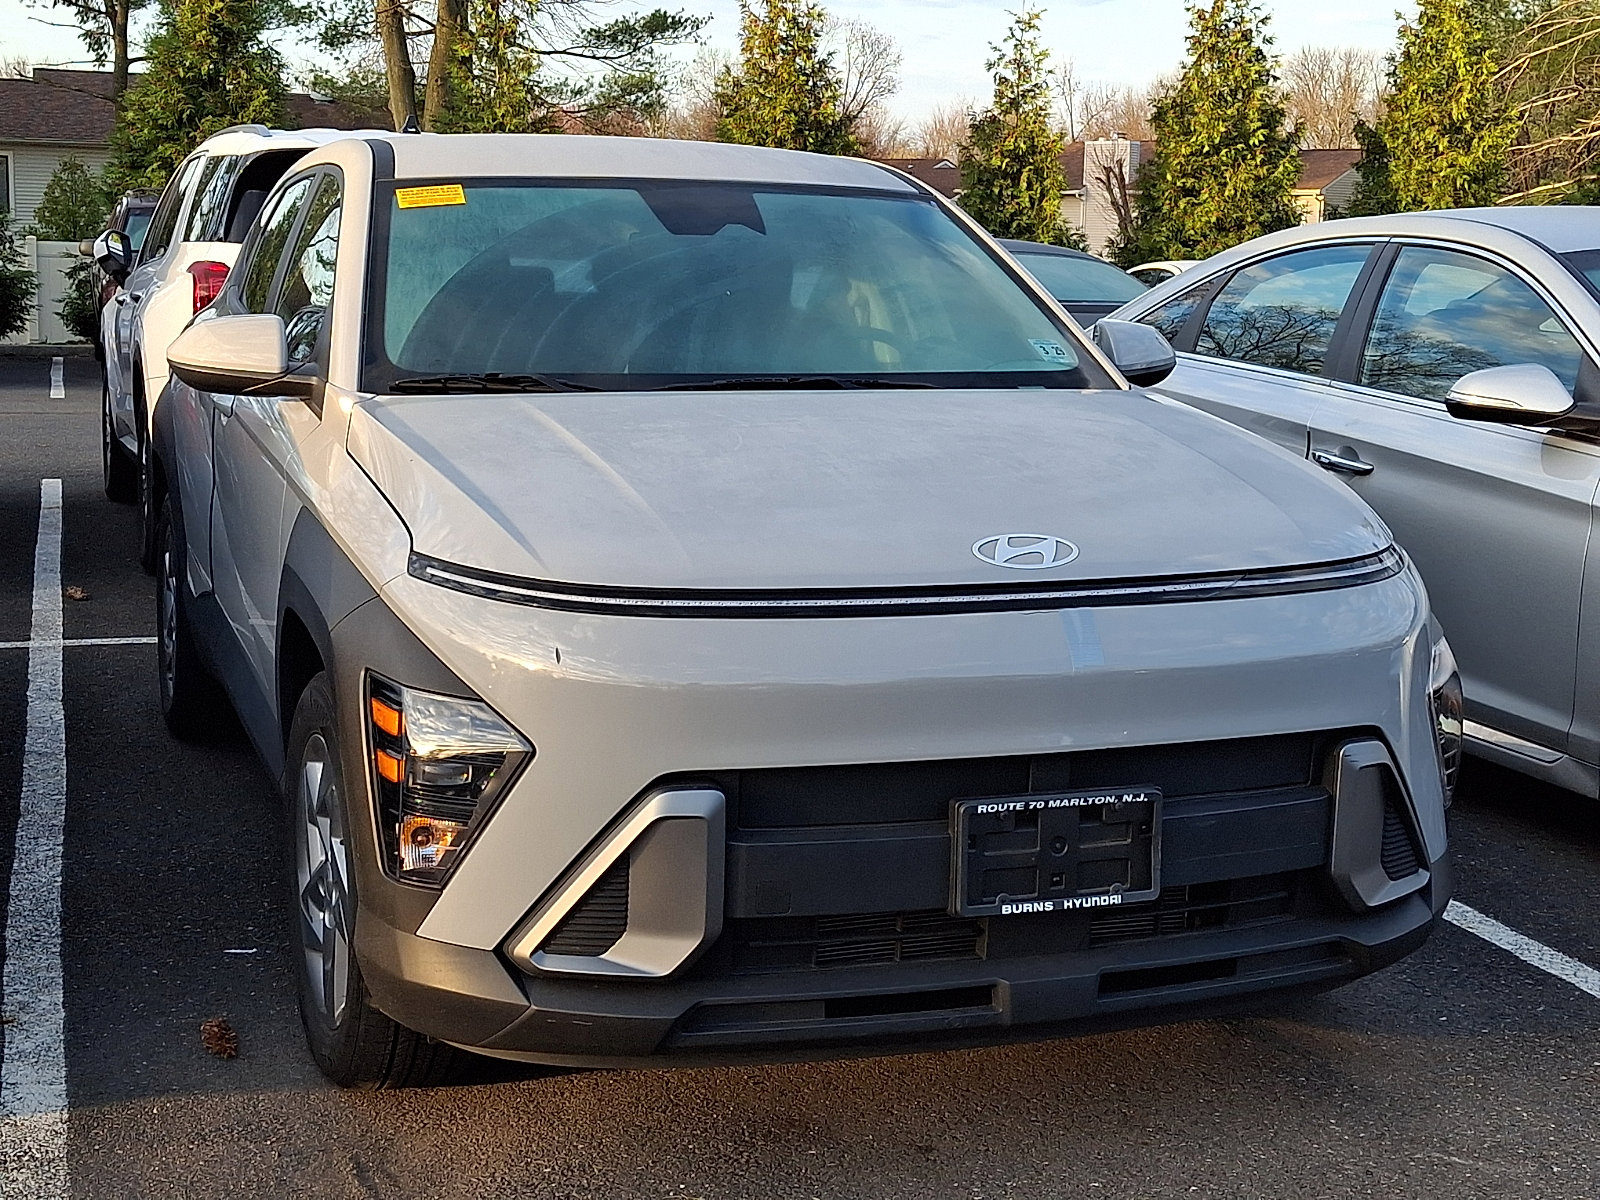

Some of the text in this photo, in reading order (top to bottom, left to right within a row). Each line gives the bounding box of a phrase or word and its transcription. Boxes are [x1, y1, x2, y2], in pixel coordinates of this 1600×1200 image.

[977, 793, 1149, 814] ROUTE 70 MARLTON, N.J.
[1001, 894, 1122, 915] BURNS HYUNDAI
